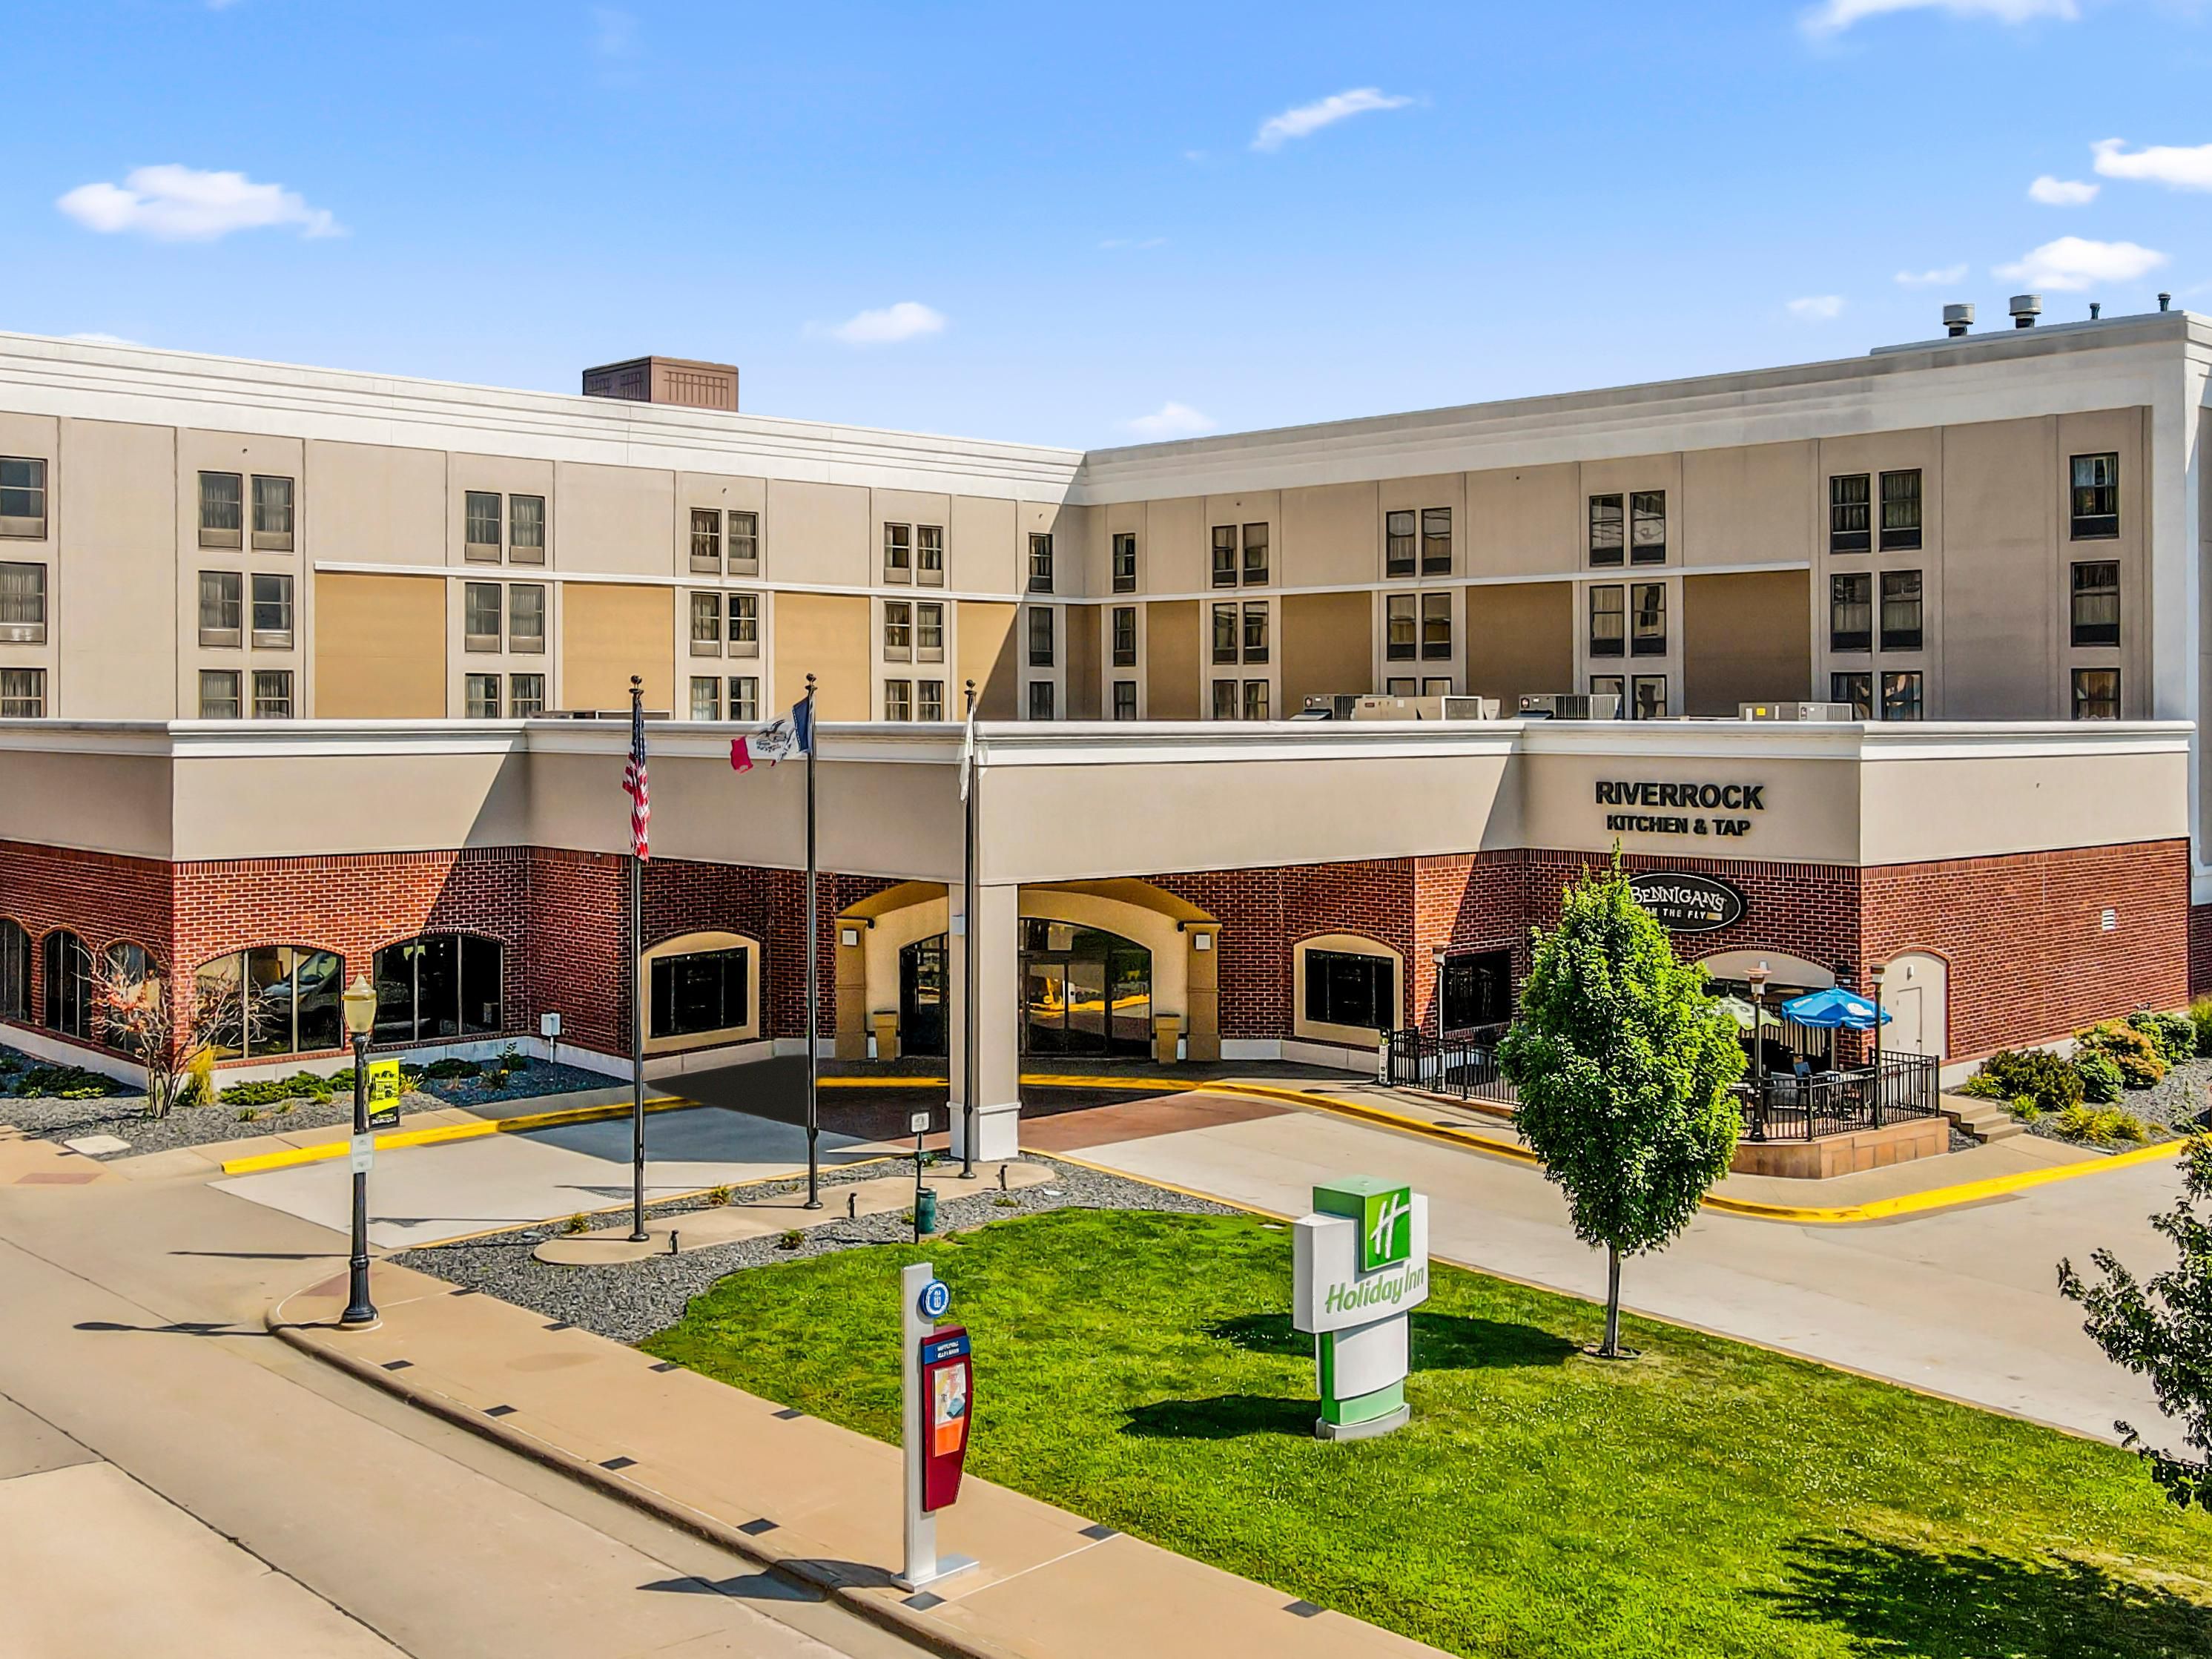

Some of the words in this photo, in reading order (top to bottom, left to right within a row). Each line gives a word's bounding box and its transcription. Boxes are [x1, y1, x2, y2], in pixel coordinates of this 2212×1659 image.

[1596, 782, 1764, 810] RIVERROCK
[1607, 815, 1688, 834] KITCHEN
[1693, 818, 1707, 835] &
[1712, 819, 1751, 837] TAP
[1663, 908, 1682, 917] THE
[1688, 910, 1706, 920] FLY
[1325, 1274, 1404, 1314] Holiday
[1404, 1264, 1424, 1293] Inn
